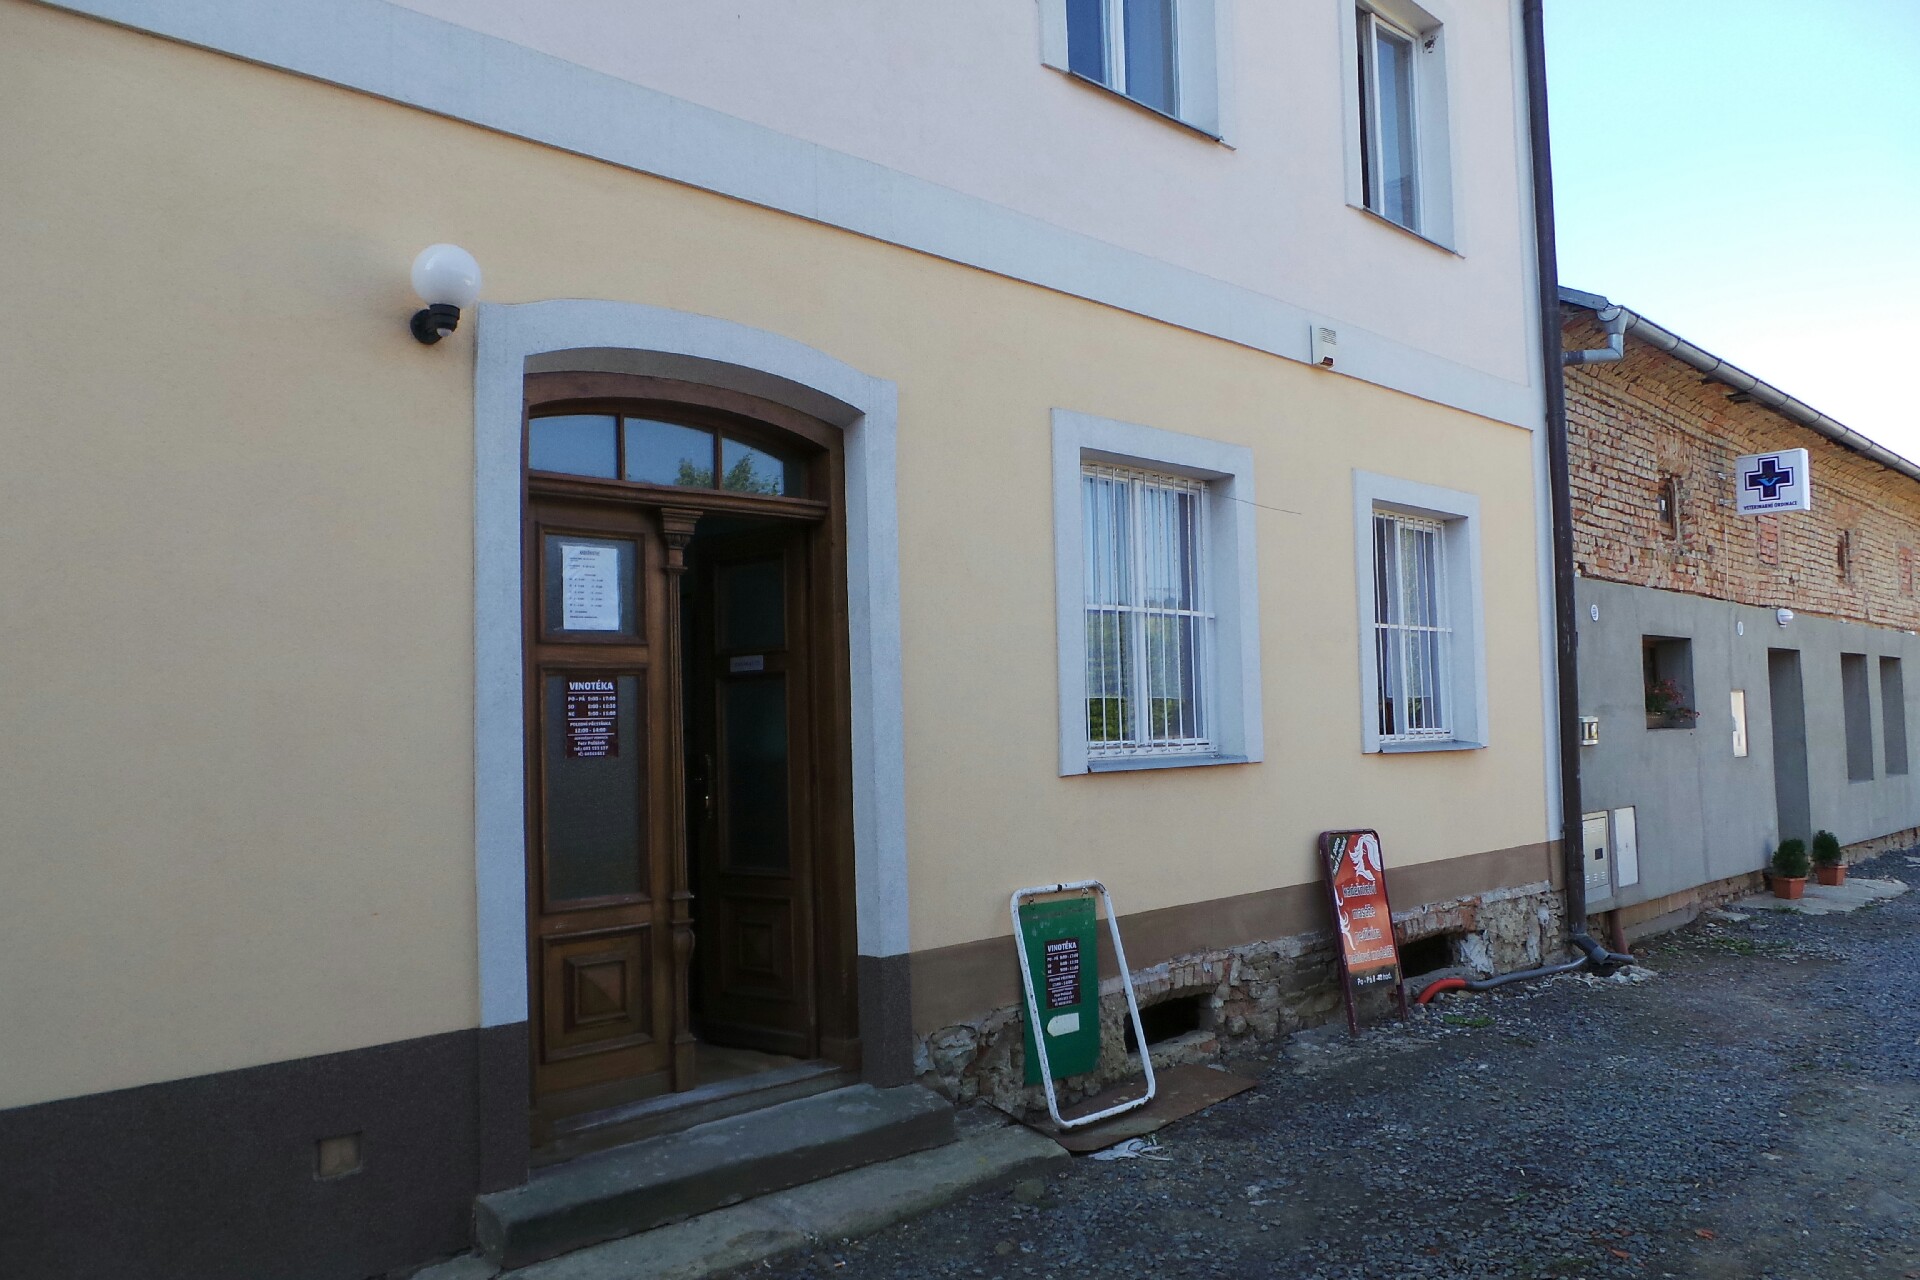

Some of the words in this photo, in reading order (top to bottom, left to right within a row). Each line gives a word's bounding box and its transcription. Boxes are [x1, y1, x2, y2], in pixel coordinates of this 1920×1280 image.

[568, 679, 614, 691] VINOTÉKA
[1047, 941, 1077, 953] VINOTÉKA
[1357, 978, 1363, 986] Po
